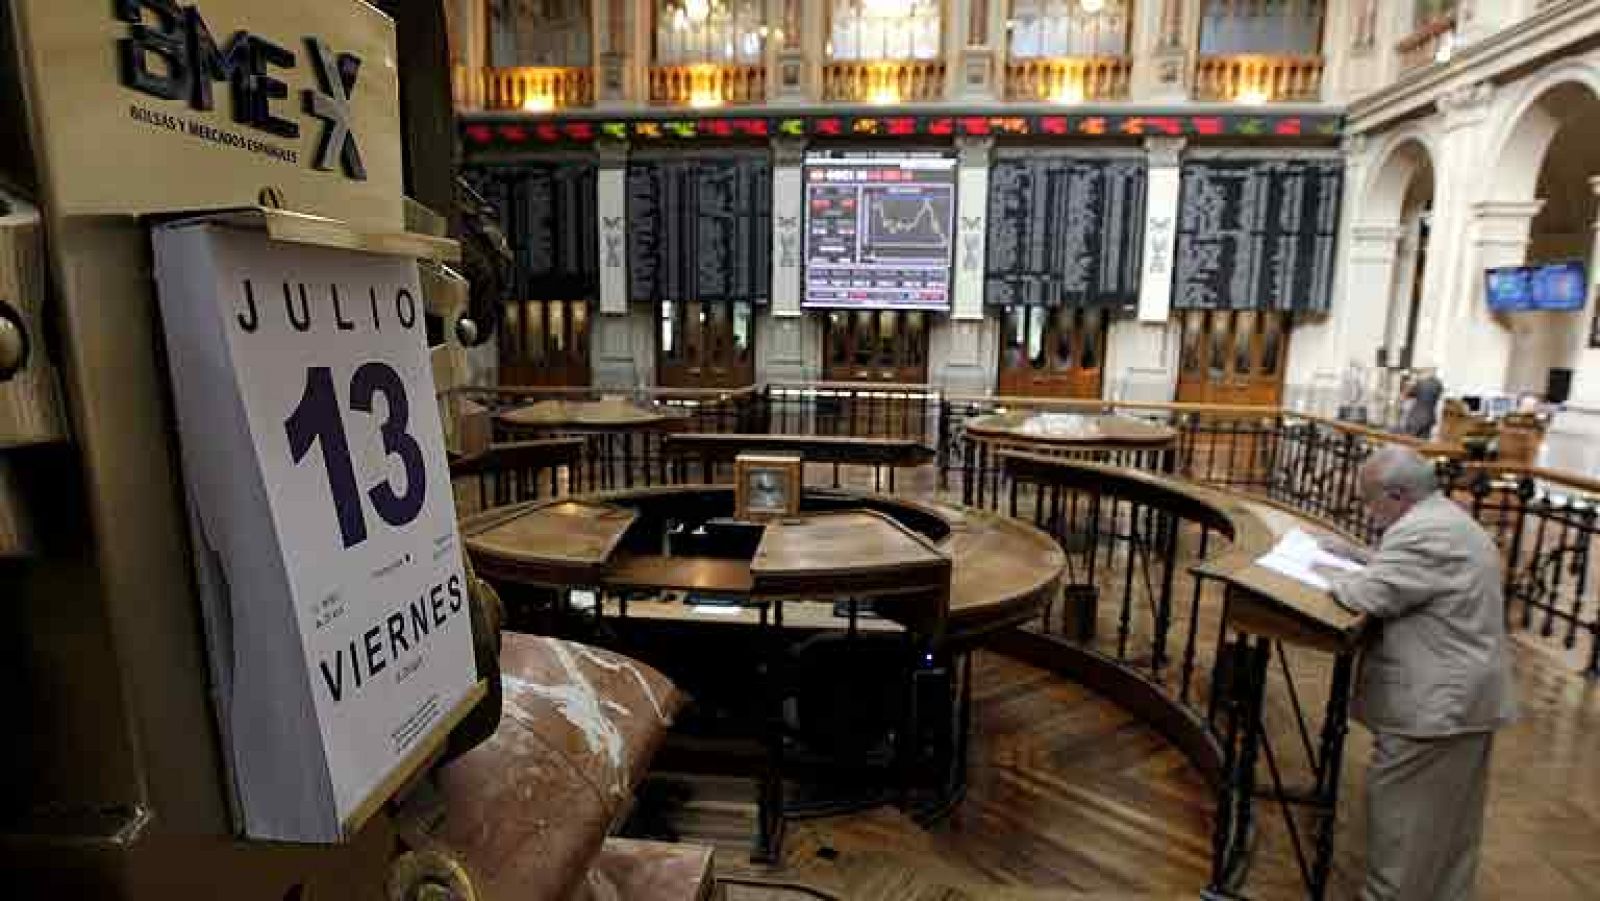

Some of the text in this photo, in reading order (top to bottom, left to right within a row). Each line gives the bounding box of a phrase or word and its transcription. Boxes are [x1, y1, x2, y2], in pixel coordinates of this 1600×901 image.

[129, 104, 176, 131] BOLSAS
[177, 117, 185, 132] Y
[188, 119, 247, 149] MERCADOS
[237, 279, 416, 333] JULIO
[284, 362, 426, 550] 13
[319, 574, 461, 702] VIERNES
